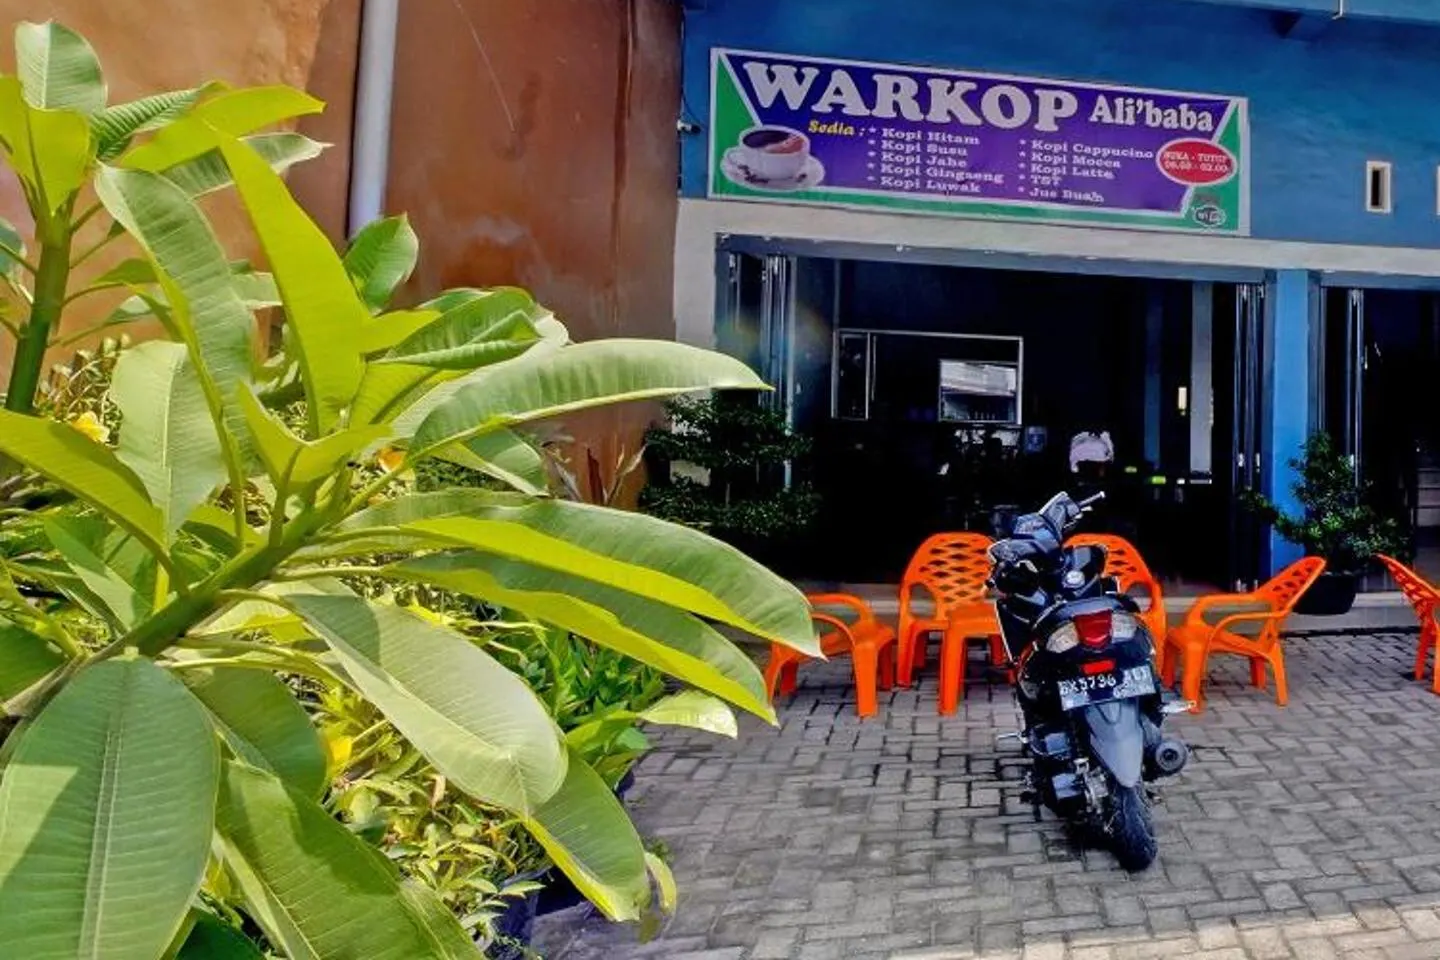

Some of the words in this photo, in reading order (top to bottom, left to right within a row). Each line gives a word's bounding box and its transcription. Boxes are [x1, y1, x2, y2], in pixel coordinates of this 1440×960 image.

[742, 61, 1079, 132] WARKOP
[808, 120, 854, 135] Sedia
[882, 127, 922, 141] Kopi
[927, 131, 980, 145] Hitam
[881, 139, 921, 154] Kopi
[926, 143, 968, 156] Susu
[1031, 139, 1068, 153] Kopi
[1073, 143, 1154, 158] Cappucino
[881, 151, 921, 165] Kopi
[926, 155, 967, 168] Jahe
[1031, 151, 1068, 165] Kopi
[881, 163, 920, 177] Kopi
[1030, 163, 1067, 176] Kopi
[1072, 166, 1116, 179] Latte
[880, 176, 921, 189] Kopi
[926, 180, 980, 192] Luwak
[1029, 187, 1058, 198] Jus
